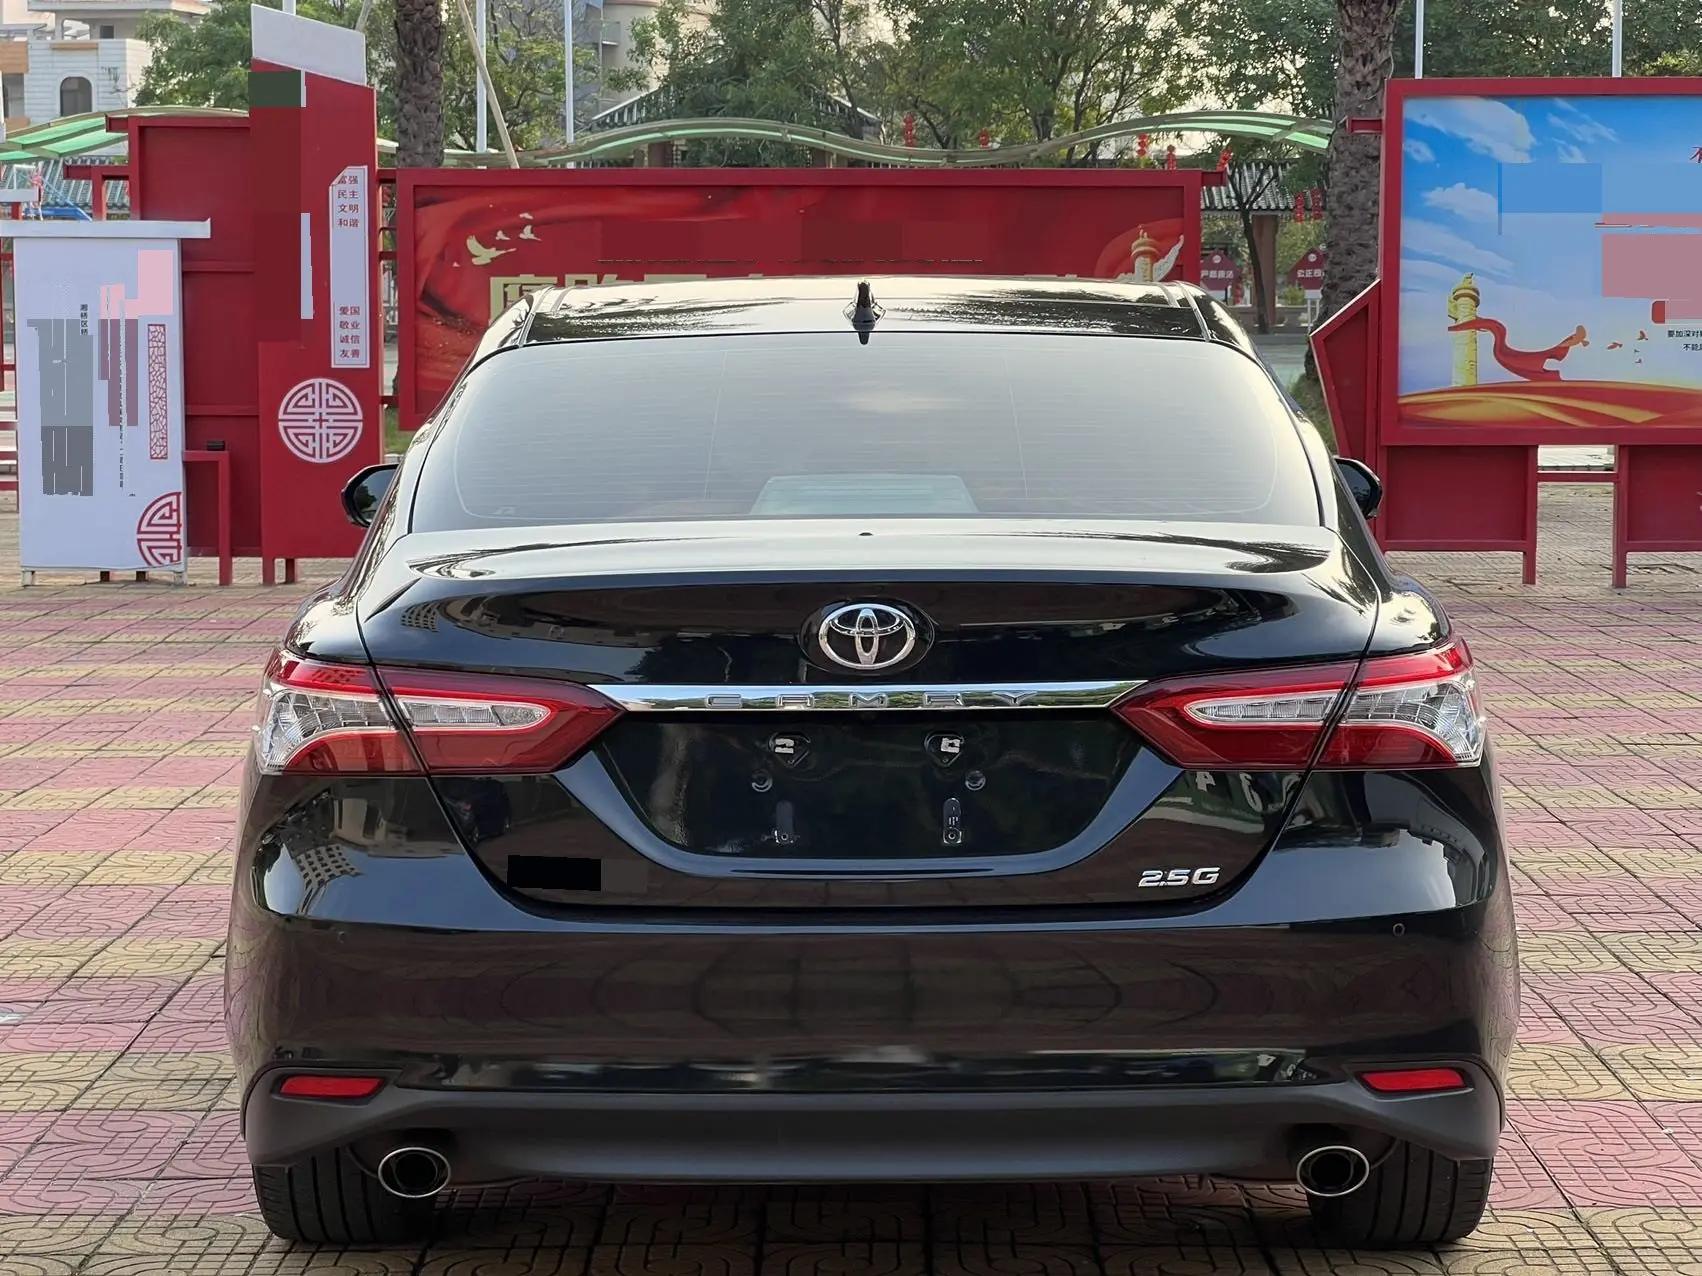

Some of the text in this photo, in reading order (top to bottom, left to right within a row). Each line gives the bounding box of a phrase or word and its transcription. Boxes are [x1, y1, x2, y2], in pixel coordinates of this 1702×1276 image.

[337, 175, 359, 185] 富强
[337, 189, 359, 199] 民主
[337, 203, 359, 213] 文明
[337, 218, 359, 228] 和谐
[339, 305, 361, 316] 爱国
[339, 320, 361, 330] 敬业
[1667, 329, 1702, 338] 要加深对
[339, 334, 361, 345] 诚信
[1682, 343, 1702, 352] 不能
[339, 349, 361, 359] 友善
[705, 691, 1037, 708] CAMRY
